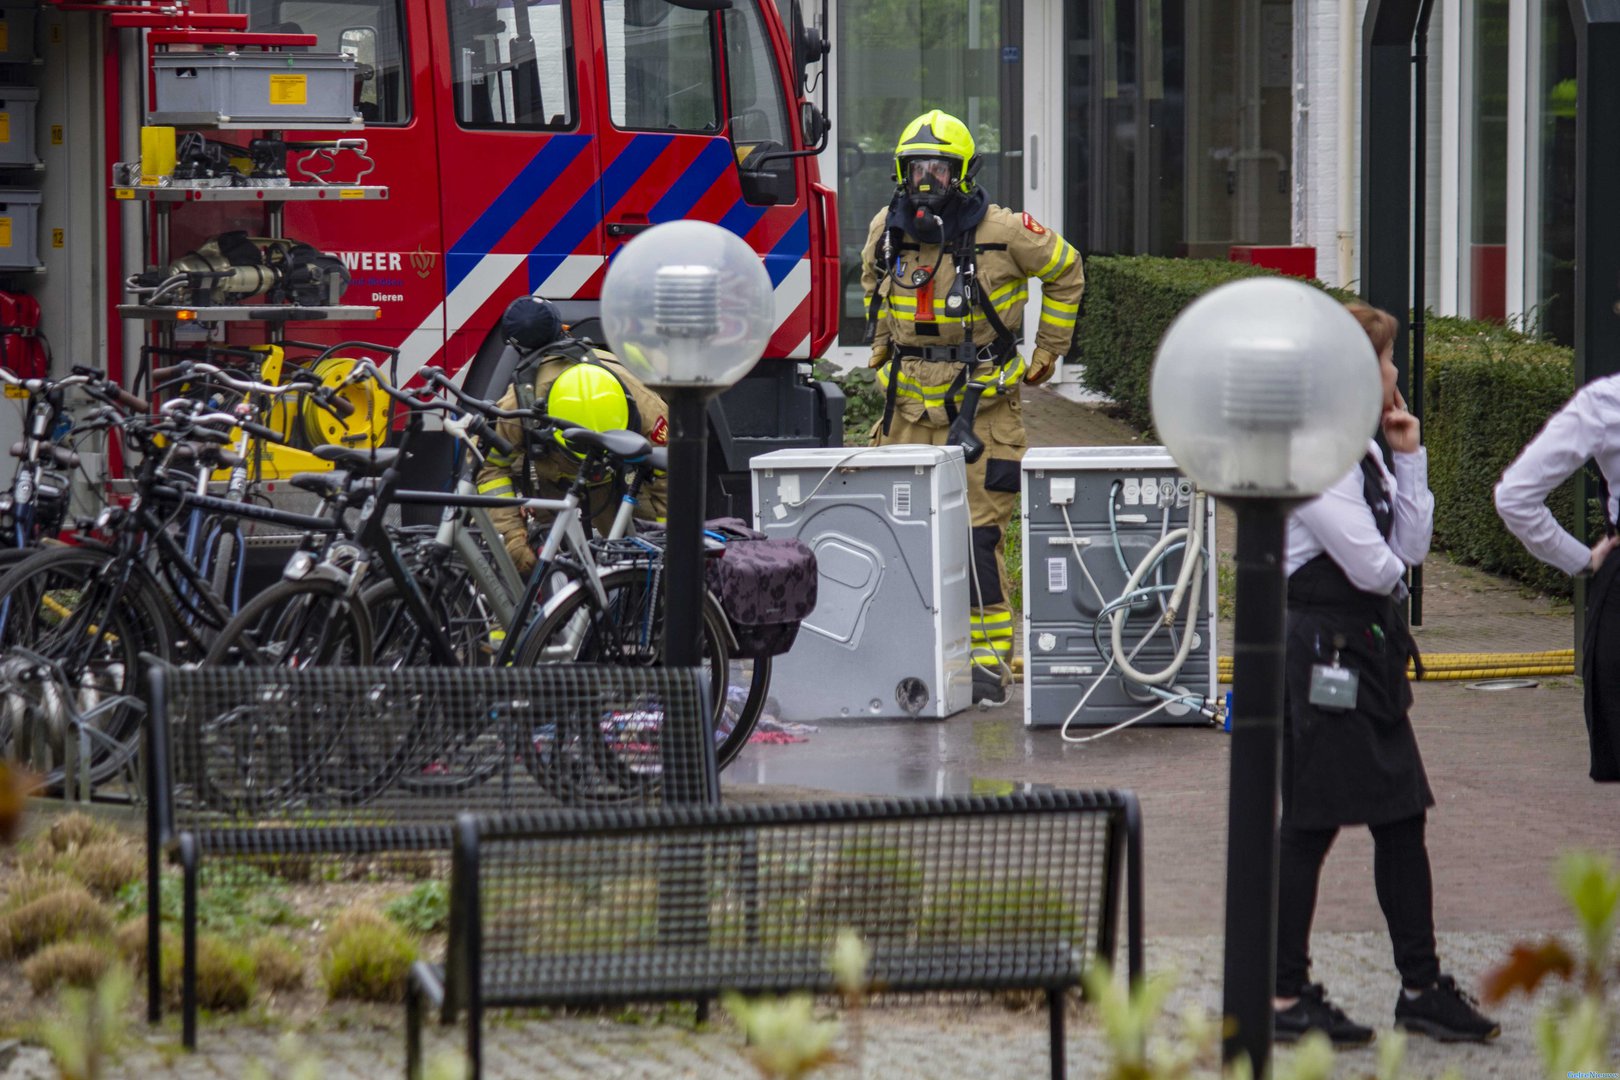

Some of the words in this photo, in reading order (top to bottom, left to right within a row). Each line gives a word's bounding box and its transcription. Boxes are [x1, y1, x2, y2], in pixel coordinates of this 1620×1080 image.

[53, 230, 64, 244] 12
[325, 251, 402, 271] WEER
[371, 292, 404, 302] Dieren
